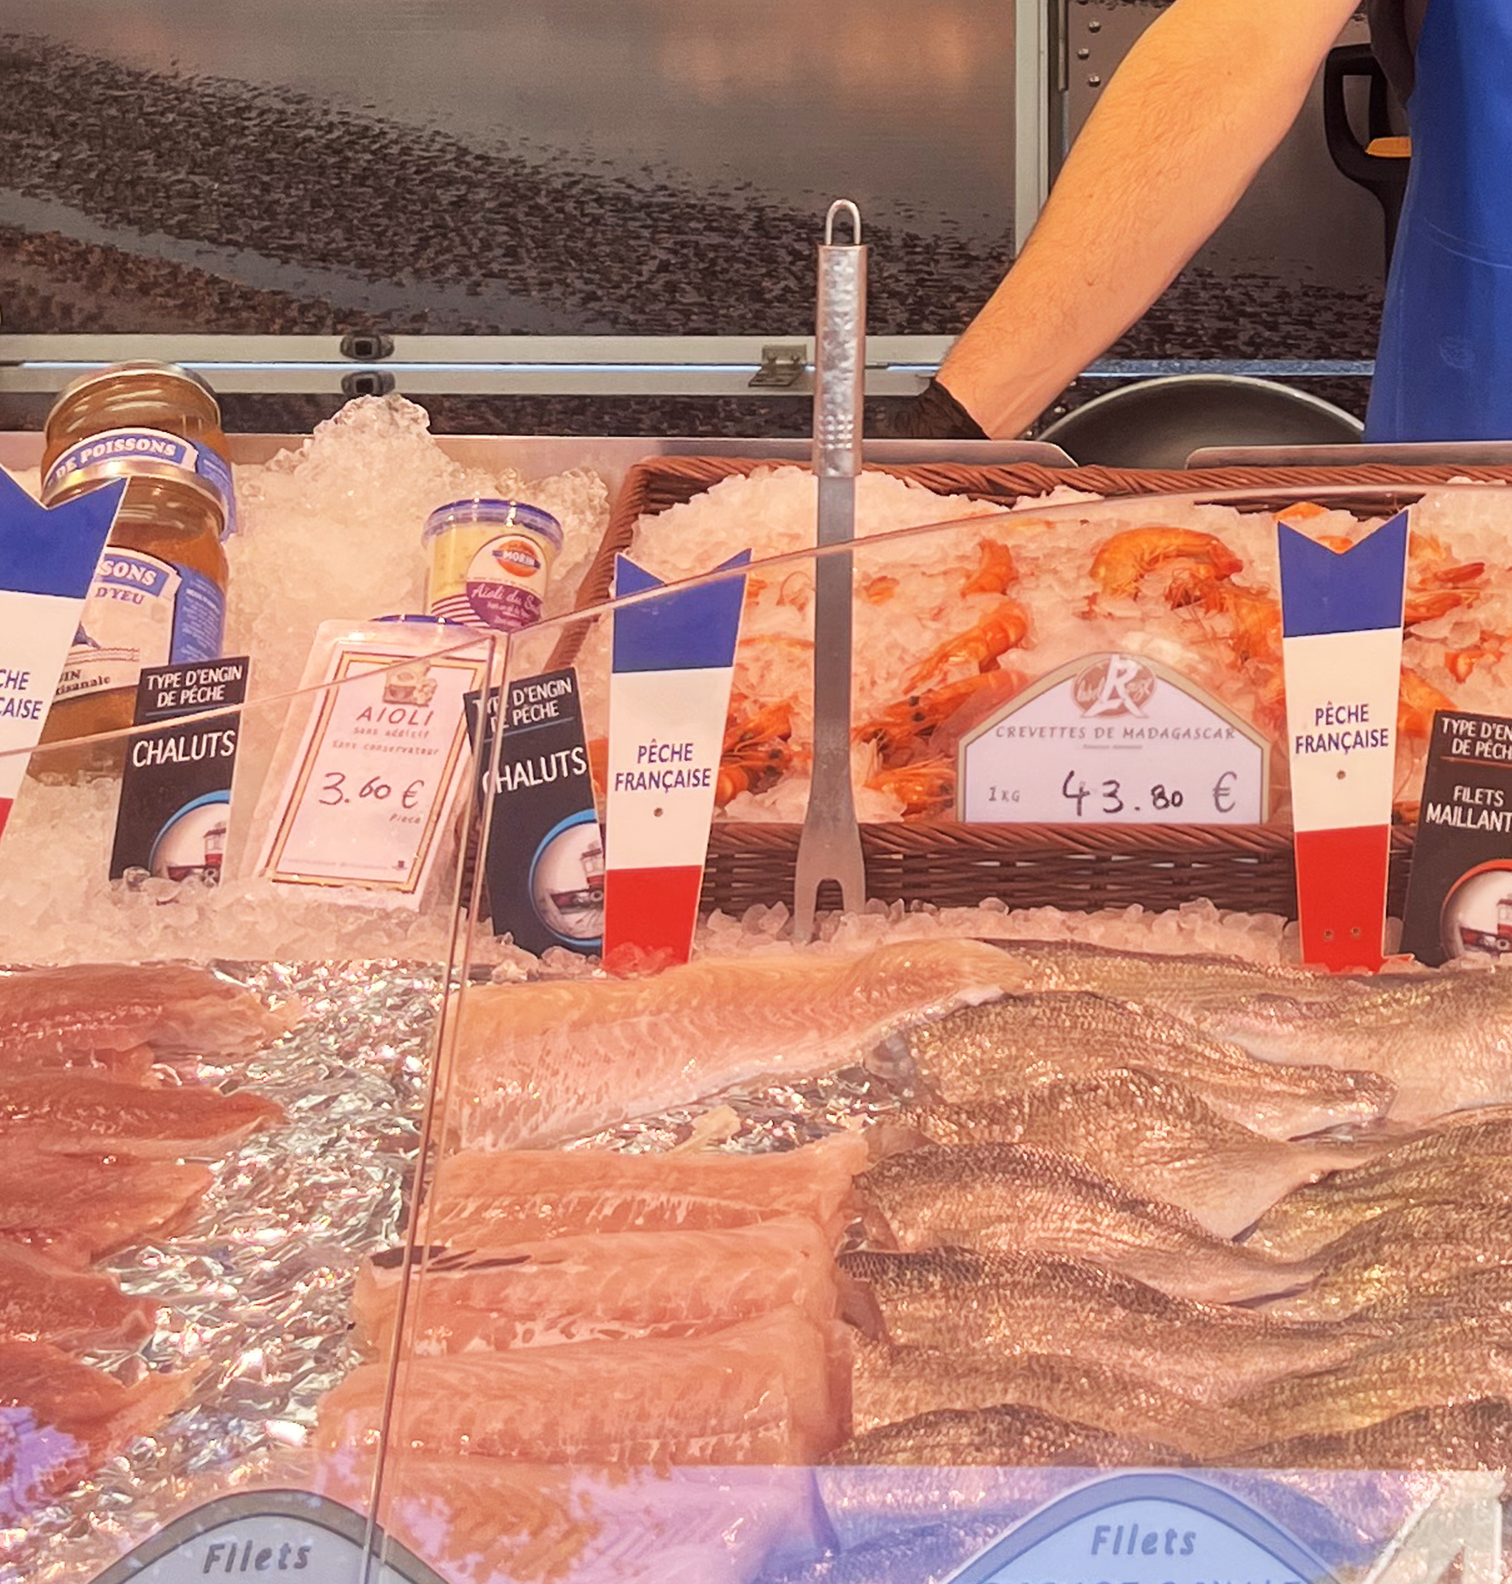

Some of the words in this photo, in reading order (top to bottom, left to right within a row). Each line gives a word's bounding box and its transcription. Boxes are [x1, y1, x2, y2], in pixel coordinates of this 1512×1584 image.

[80, 437, 177, 464] POISSONS
[147, 672, 182, 691] TYPE
[185, 666, 243, 686] D'ENGIN
[512, 677, 573, 707] D'ENGIN
[157, 691, 176, 708] DE
[180, 684, 226, 705] PÊCHE
[356, 706, 435, 727] AIOLI
[512, 700, 560, 726] PÊCHE
[1314, 700, 1370, 727] PÊCHE
[995, 725, 1086, 740] CREVETTES
[1094, 725, 1115, 739] DE
[1122, 726, 1237, 741] MADAGASCAR
[1440, 717, 1476, 737] TYPE
[133, 730, 236, 767] CHALUTS
[637, 737, 694, 764] PÊCHE
[1295, 727, 1389, 756] FRANÇAISE
[1451, 737, 1472, 756] DE
[614, 767, 712, 794] FRANÇAISE
[1212, 770, 1238, 814] €
[401, 779, 426, 810] €
[1452, 784, 1505, 808] FILETS
[1090, 1523, 1198, 1557] Filets
[202, 1539, 313, 1574] Filets
